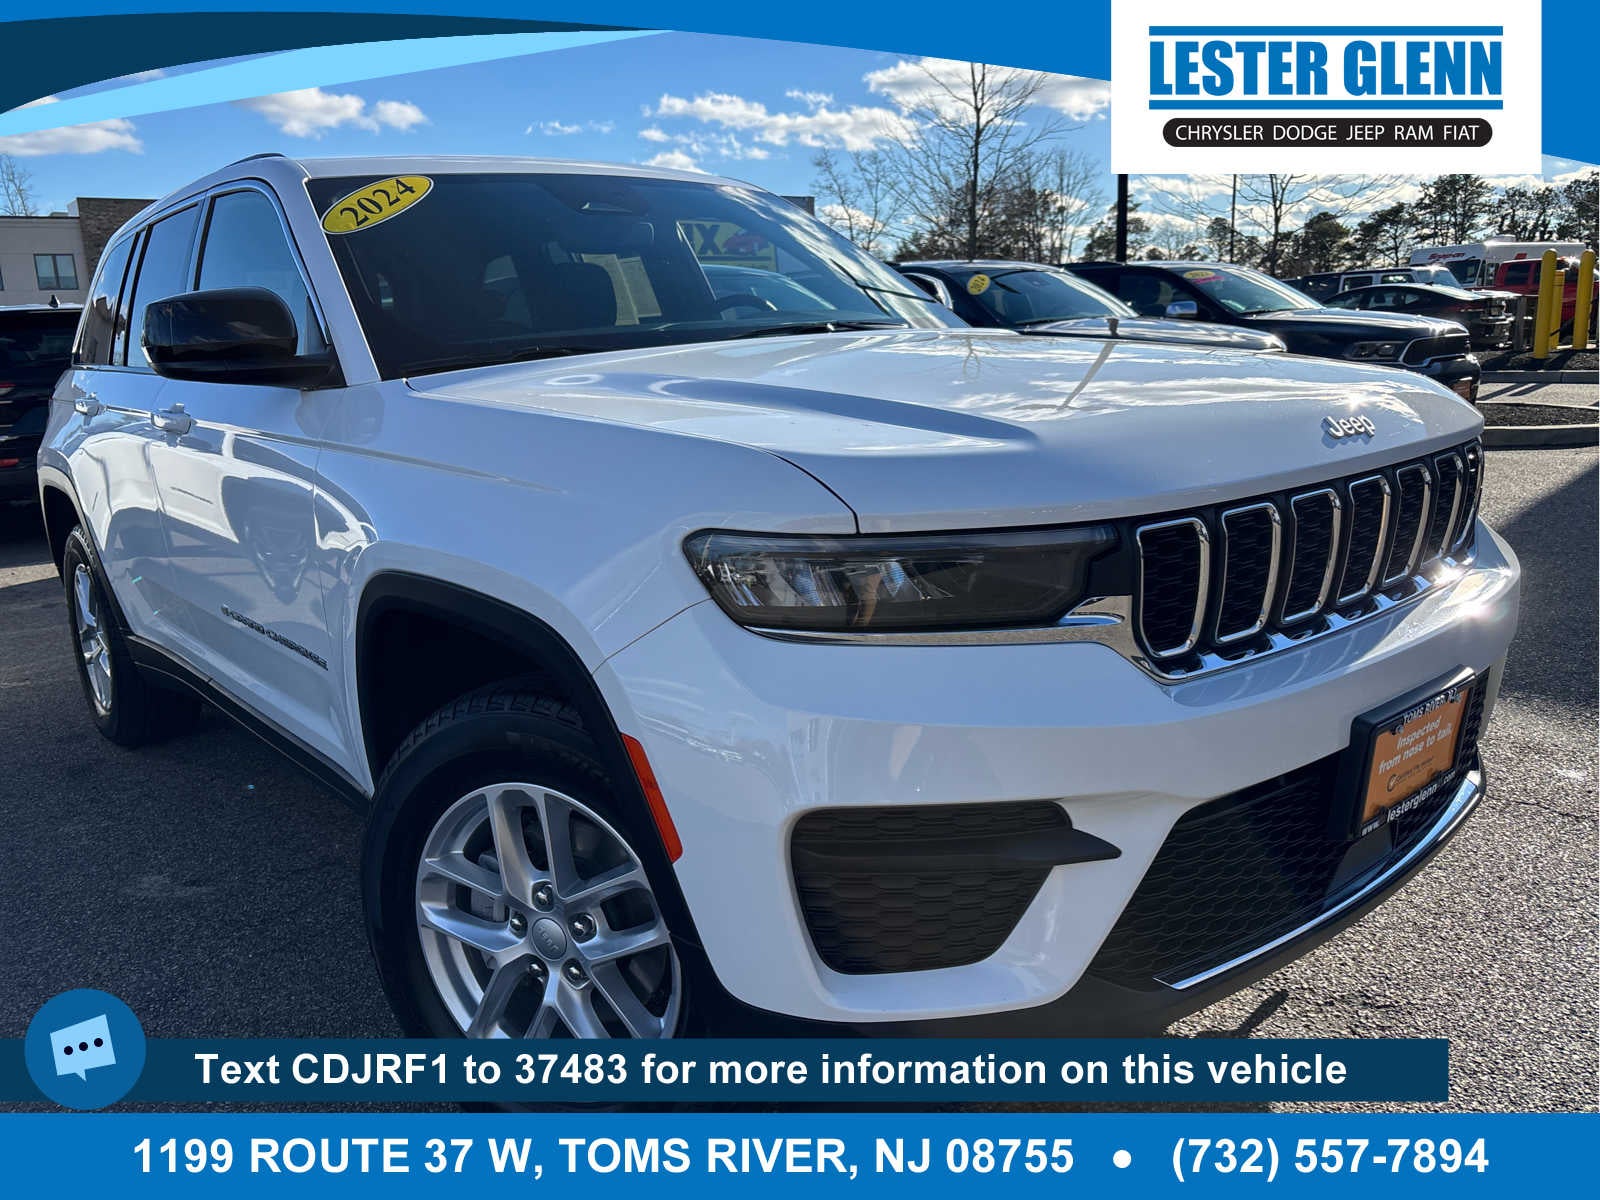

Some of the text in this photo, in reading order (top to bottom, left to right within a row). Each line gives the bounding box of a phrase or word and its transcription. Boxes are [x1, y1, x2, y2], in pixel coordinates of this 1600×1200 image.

[340, 178, 415, 226] 2024
[1326, 414, 1376, 439] Jeep
[1397, 715, 1442, 750] Inspected
[1403, 706, 1424, 726] TOMS
[1378, 754, 1401, 776] from
[1402, 740, 1425, 761] nose
[1426, 734, 1436, 748] to
